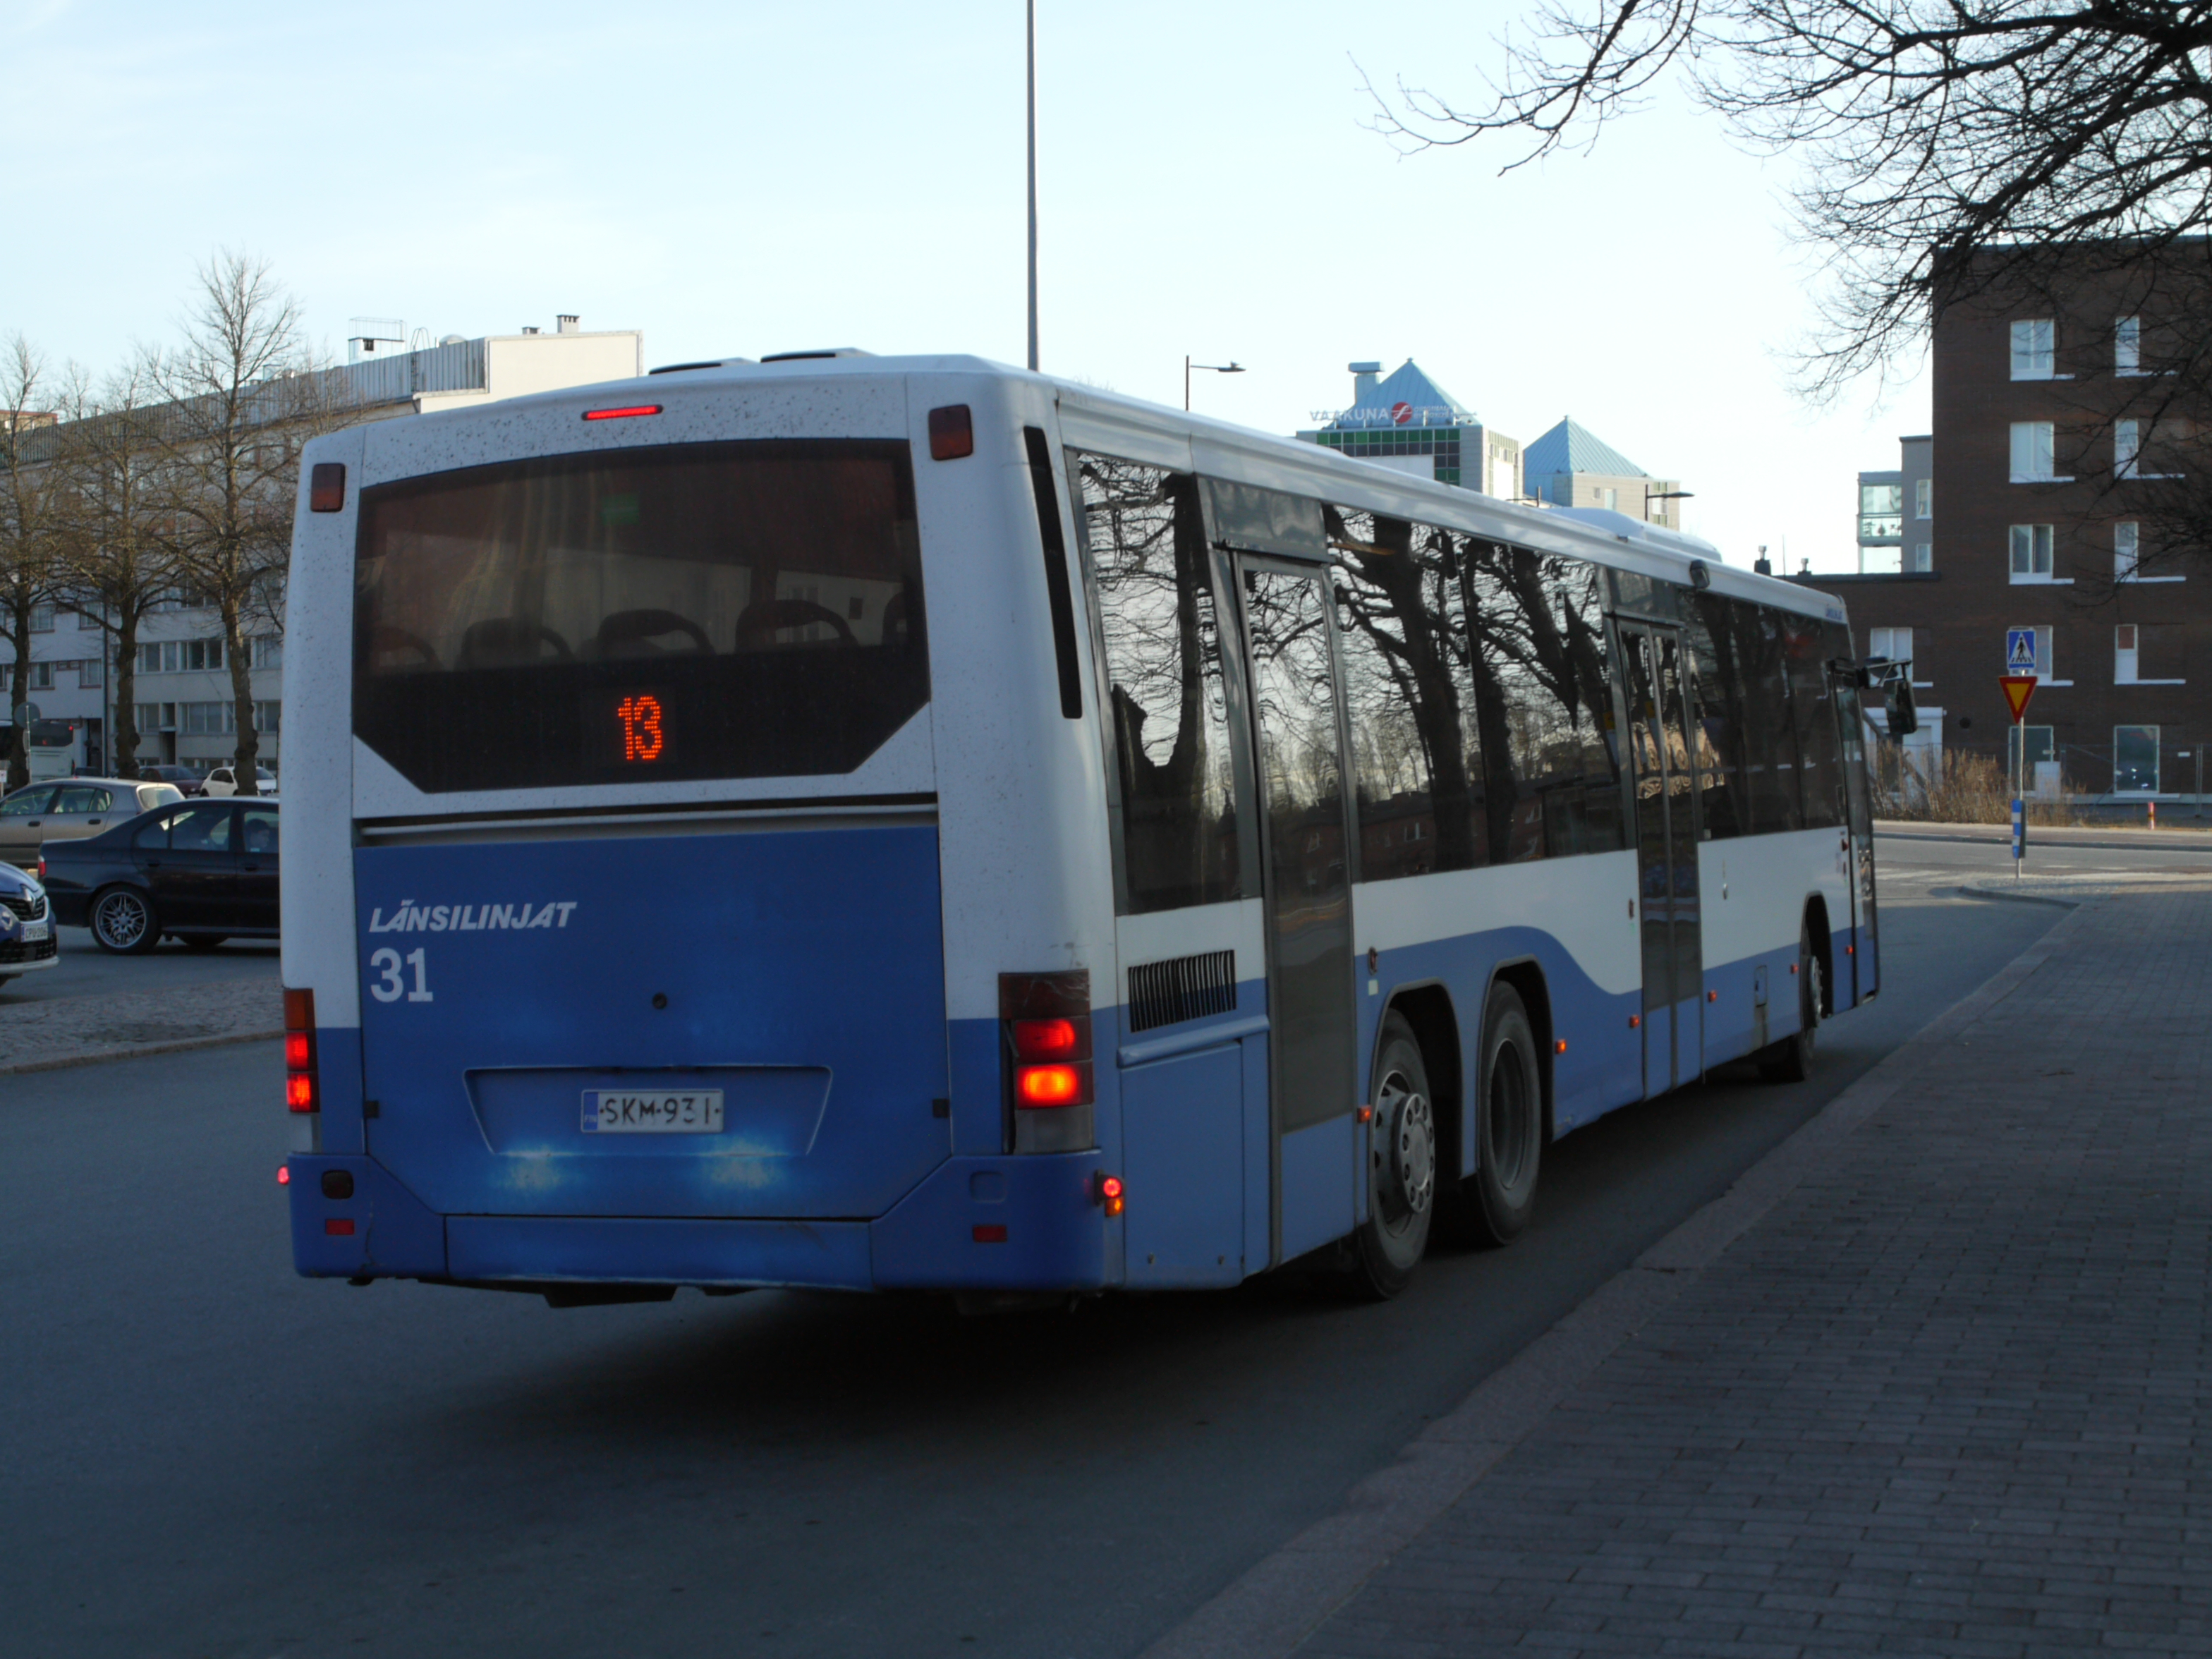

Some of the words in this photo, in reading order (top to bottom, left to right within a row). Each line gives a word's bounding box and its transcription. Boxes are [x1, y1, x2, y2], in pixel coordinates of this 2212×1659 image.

[1309, 407, 1389, 422] VAAKUNA
[618, 695, 663, 761] 13
[370, 947, 434, 1002] 31
